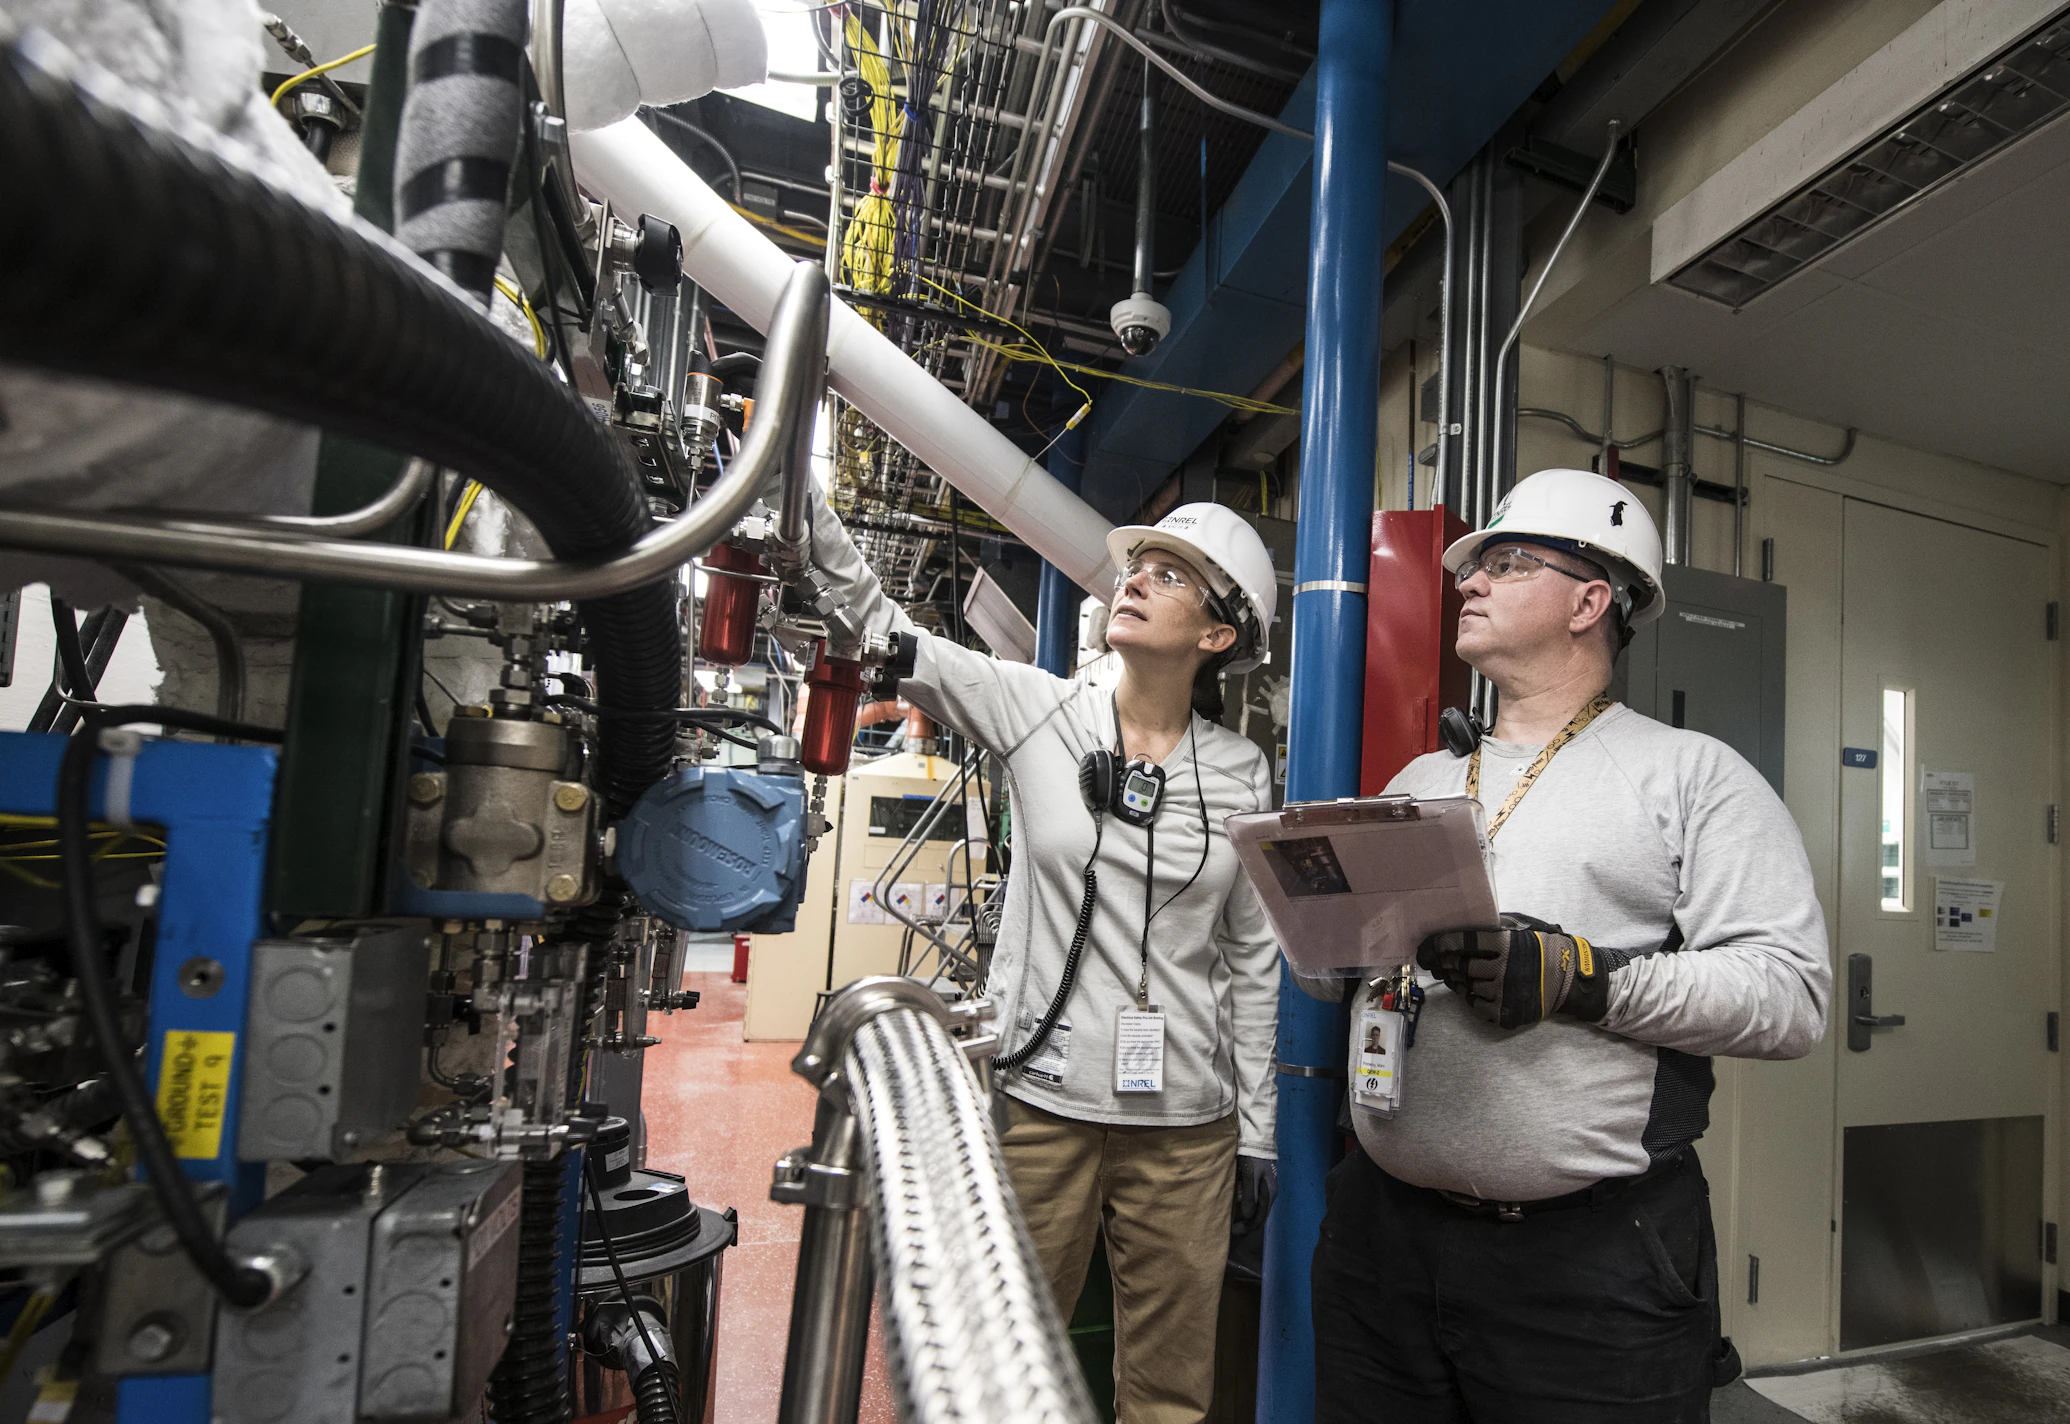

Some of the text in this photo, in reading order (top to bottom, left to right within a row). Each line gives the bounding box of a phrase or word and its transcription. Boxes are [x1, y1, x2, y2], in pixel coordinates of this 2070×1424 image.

[1170, 516, 1198, 525] NREL
[1855, 753, 1867, 763] 127
[677, 821, 758, 877] ROSEMOUNT
[1130, 1079, 1156, 1088] NREL
[196, 1081, 222, 1130] TEST
